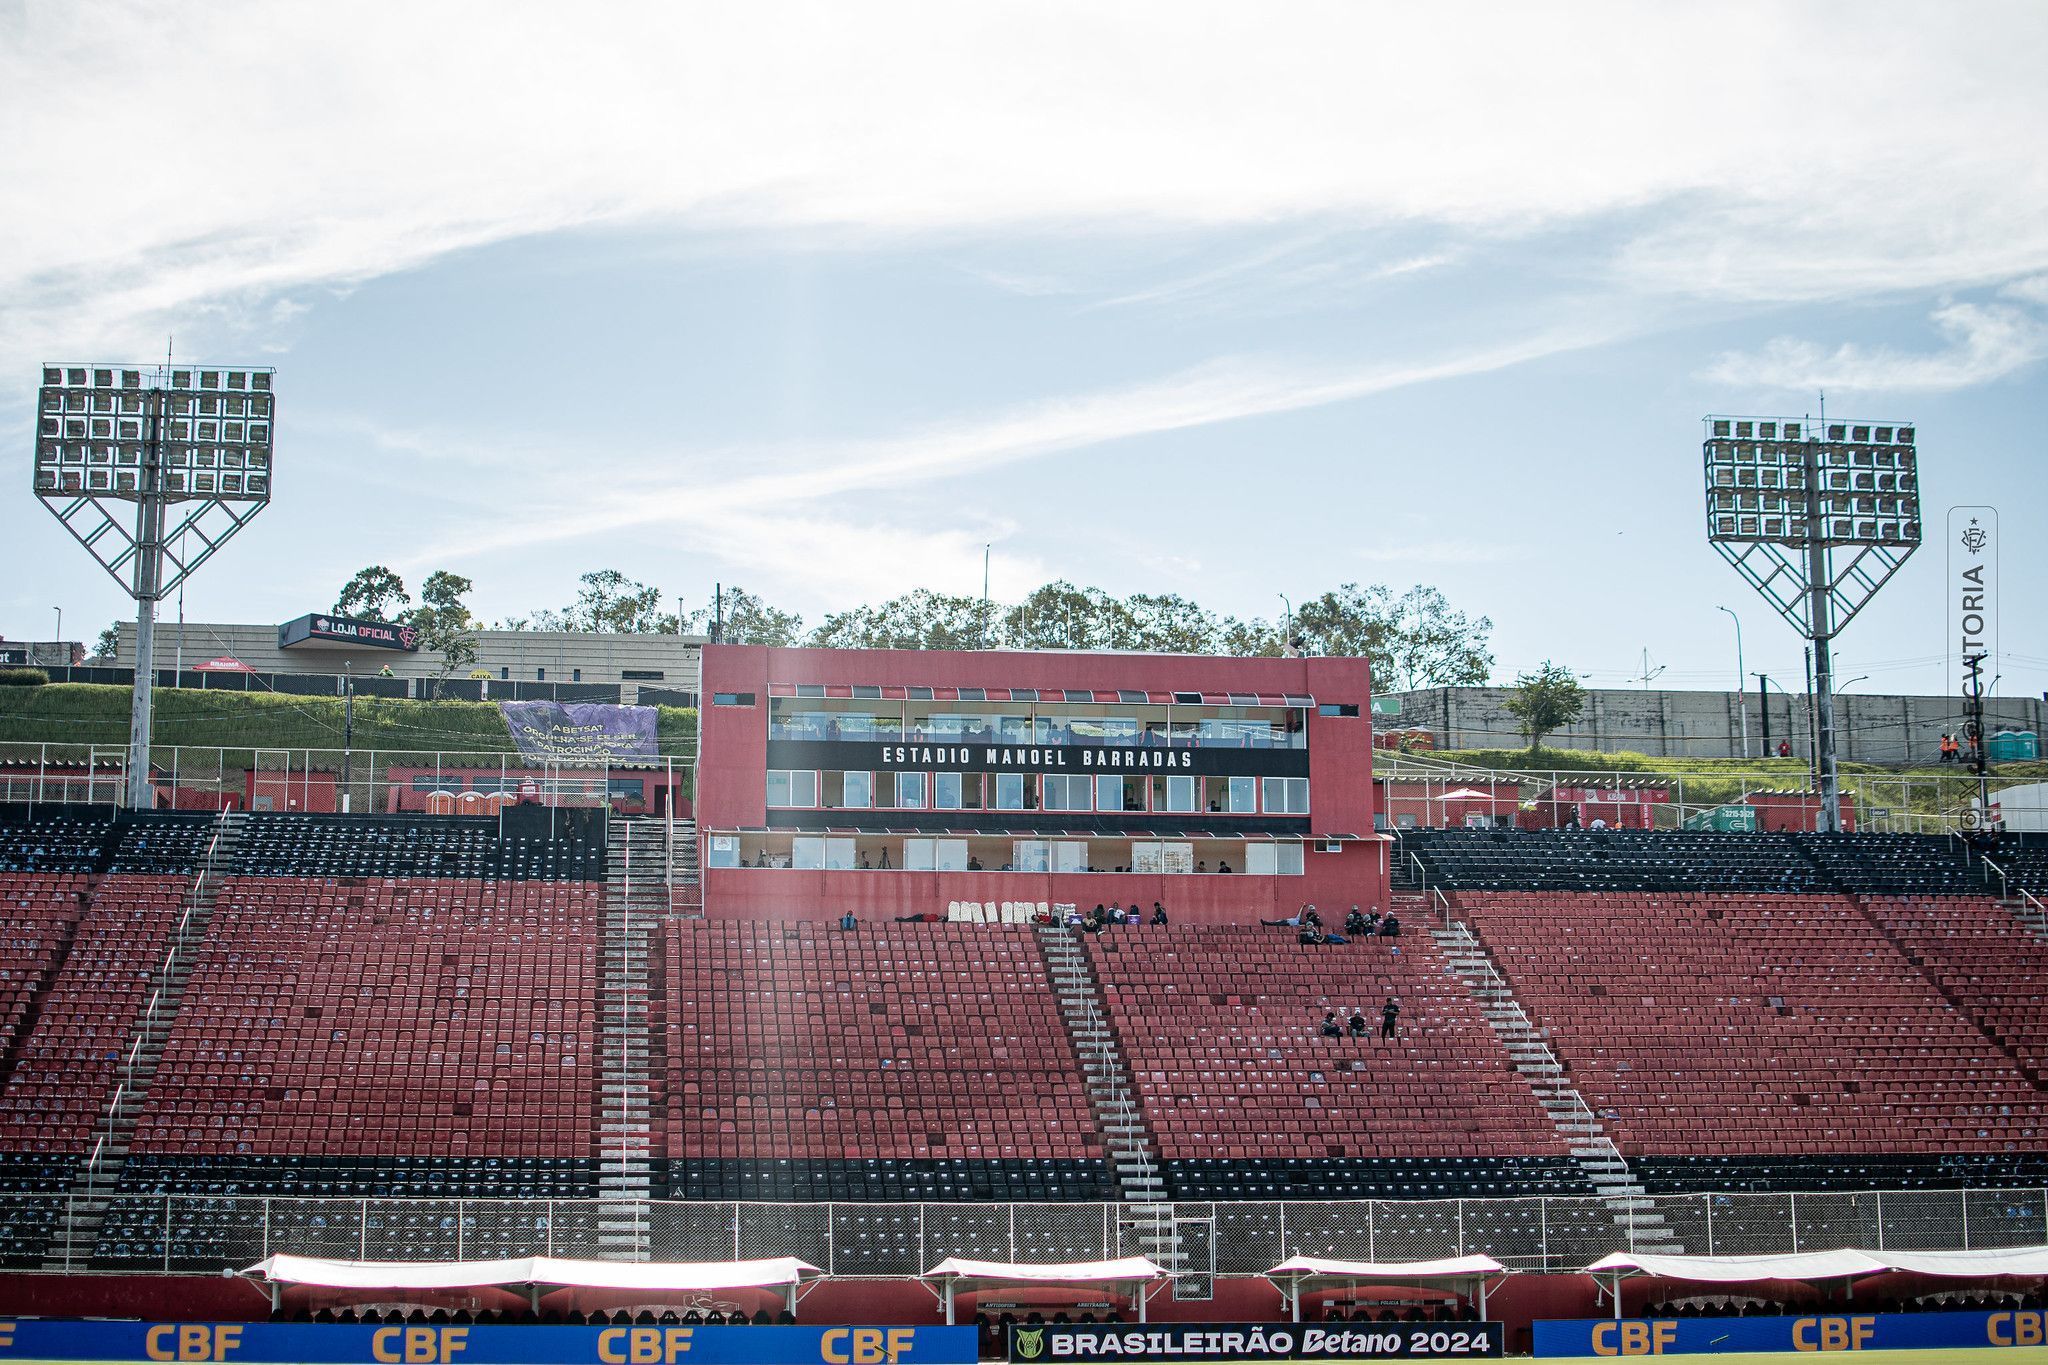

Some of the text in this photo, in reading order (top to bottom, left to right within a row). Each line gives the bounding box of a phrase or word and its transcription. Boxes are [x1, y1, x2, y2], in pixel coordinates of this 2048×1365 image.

[331, 622, 396, 641] LOJA OFICIAL
[552, 724, 604, 734] A BETSAT
[882, 746, 1191, 767] ESTADIO MANOEL BARRADAS
[146, 1325, 244, 1361] CBF
[372, 1327, 469, 1363] CBF
[597, 1328, 693, 1364] CBF
[820, 1328, 915, 1364] CBF
[1051, 1326, 1490, 1355] BRASILEIRÃO Betano 2024
[1591, 1321, 1678, 1356] CBF
[1792, 1316, 1876, 1351] CBF
[1987, 1311, 2048, 1346] CB
